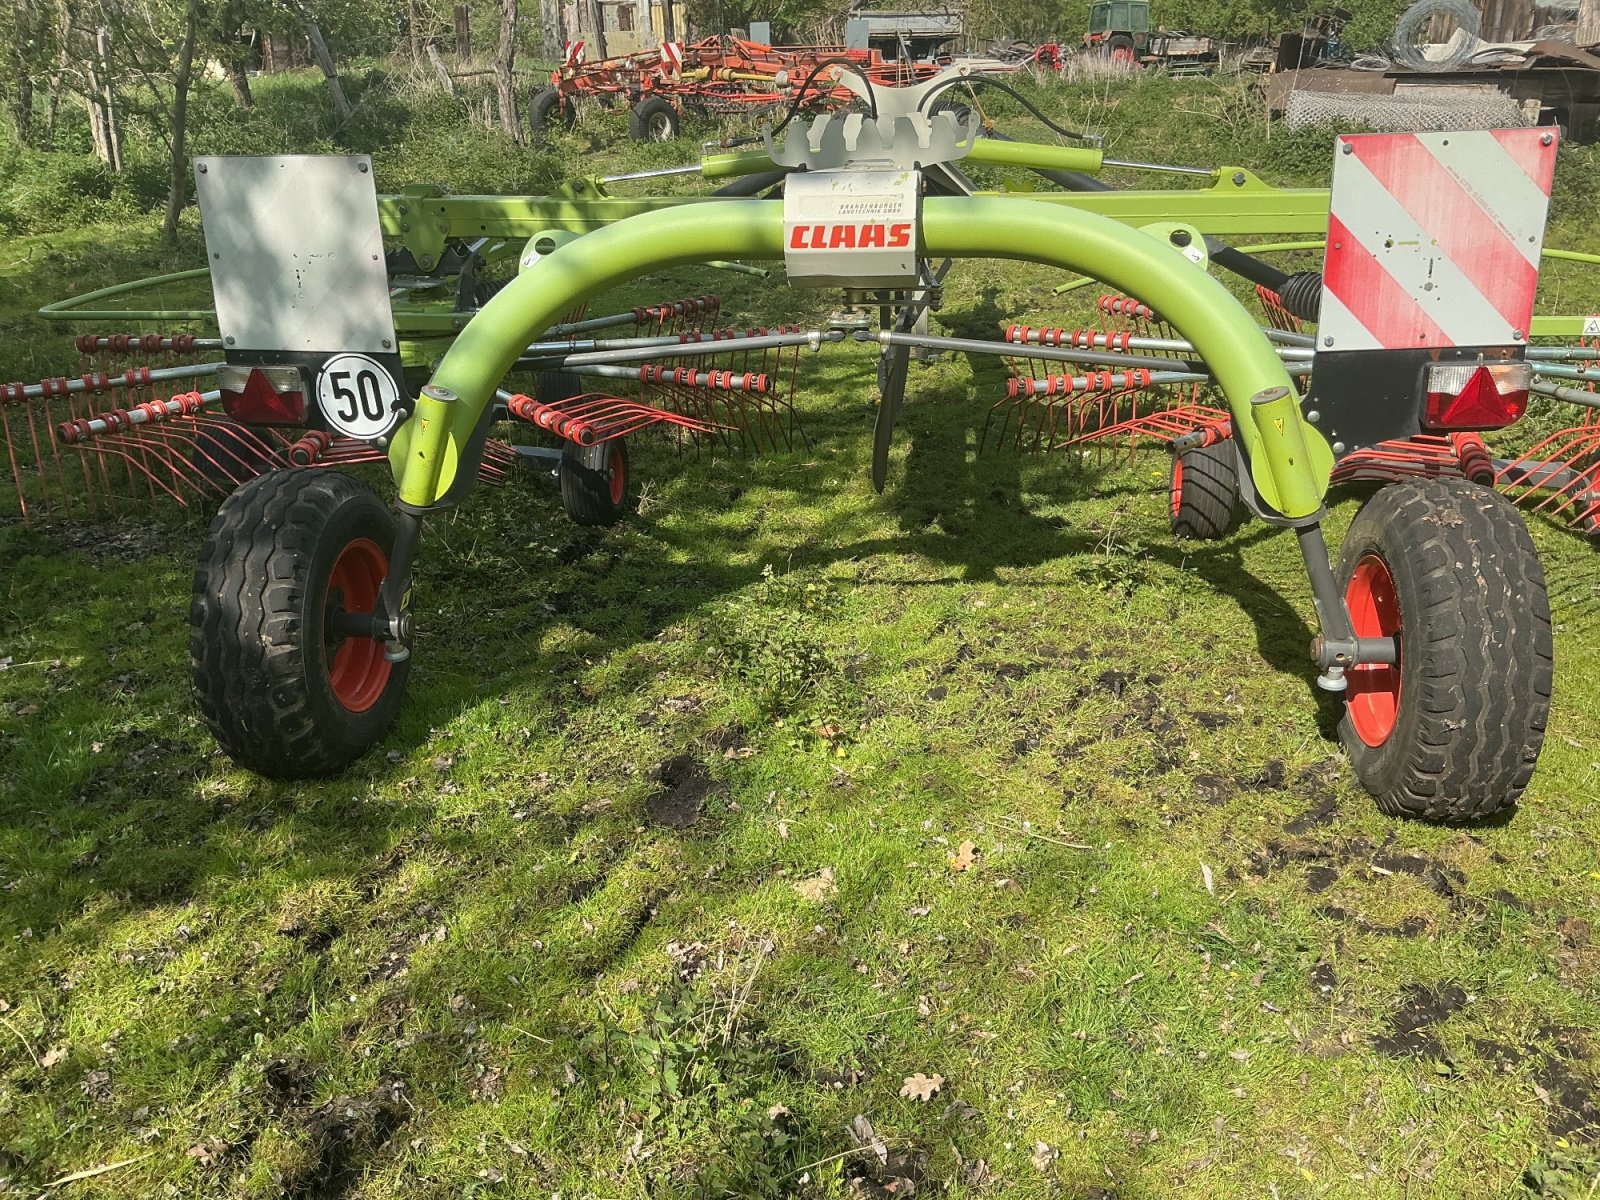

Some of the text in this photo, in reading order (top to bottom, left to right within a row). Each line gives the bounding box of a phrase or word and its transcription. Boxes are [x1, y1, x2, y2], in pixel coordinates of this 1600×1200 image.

[840, 202, 902, 210] BRANDENBURGER
[790, 223, 912, 249] CLAAS
[329, 369, 385, 423] 50
